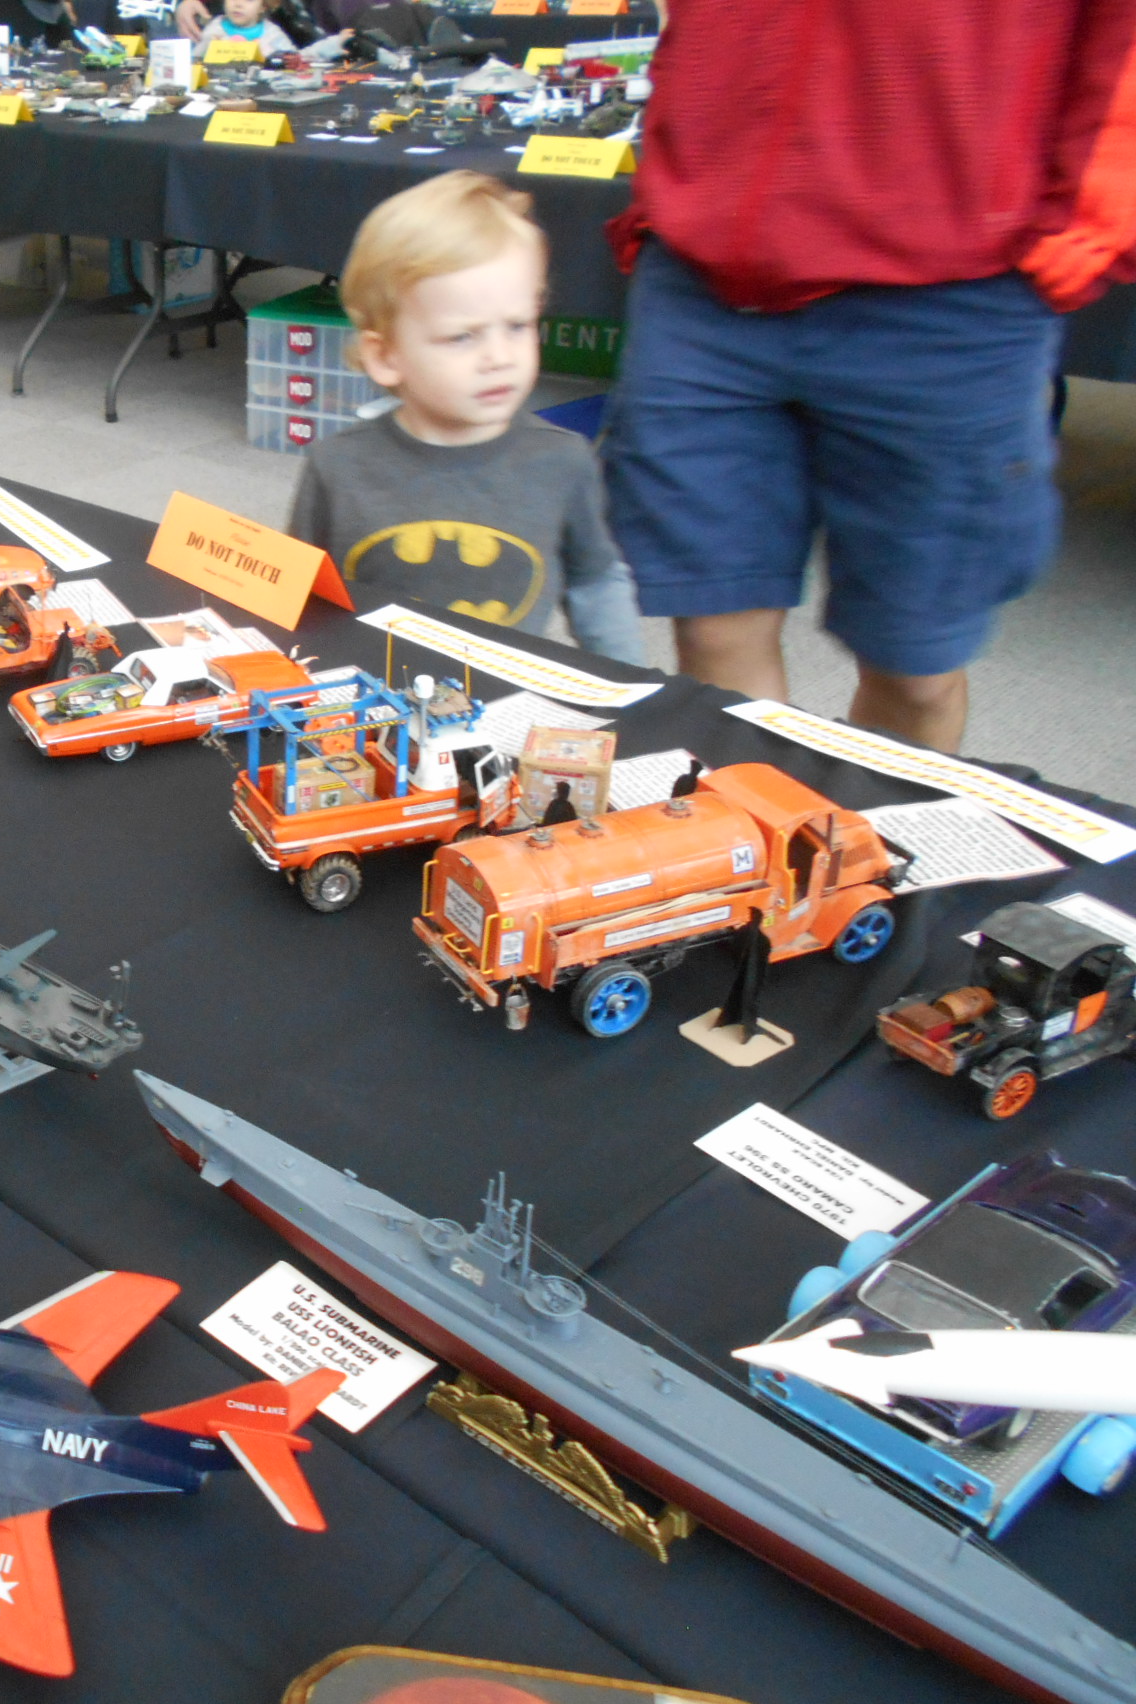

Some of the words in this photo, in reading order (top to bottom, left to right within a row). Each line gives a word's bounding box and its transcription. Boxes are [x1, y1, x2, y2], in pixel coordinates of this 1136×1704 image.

[186, 531, 205, 550] DO
[206, 540, 235, 563] NOT
[235, 552, 282, 584] TOUCH
[734, 849, 752, 867] M
[744, 1144, 770, 1161] 396
[814, 1151, 855, 1177] DANIEL
[726, 1149, 809, 1204] CHEVROLET
[791, 1174, 855, 1215] CAMARO
[813, 1202, 847, 1226] 1970
[229, 1312, 259, 1336] Model
[287, 1301, 312, 1323] USS
[313, 1318, 379, 1366] LIONFISH
[292, 1284, 317, 1306] U.S.
[318, 1304, 402, 1361] SUBMARINE
[271, 1311, 321, 1347] BALAO
[321, 1345, 366, 1378] CLASS
[226, 1400, 258, 1412] CHINA
[258, 1404, 288, 1415] LAKE
[42, 1428, 110, 1463] NAVY
